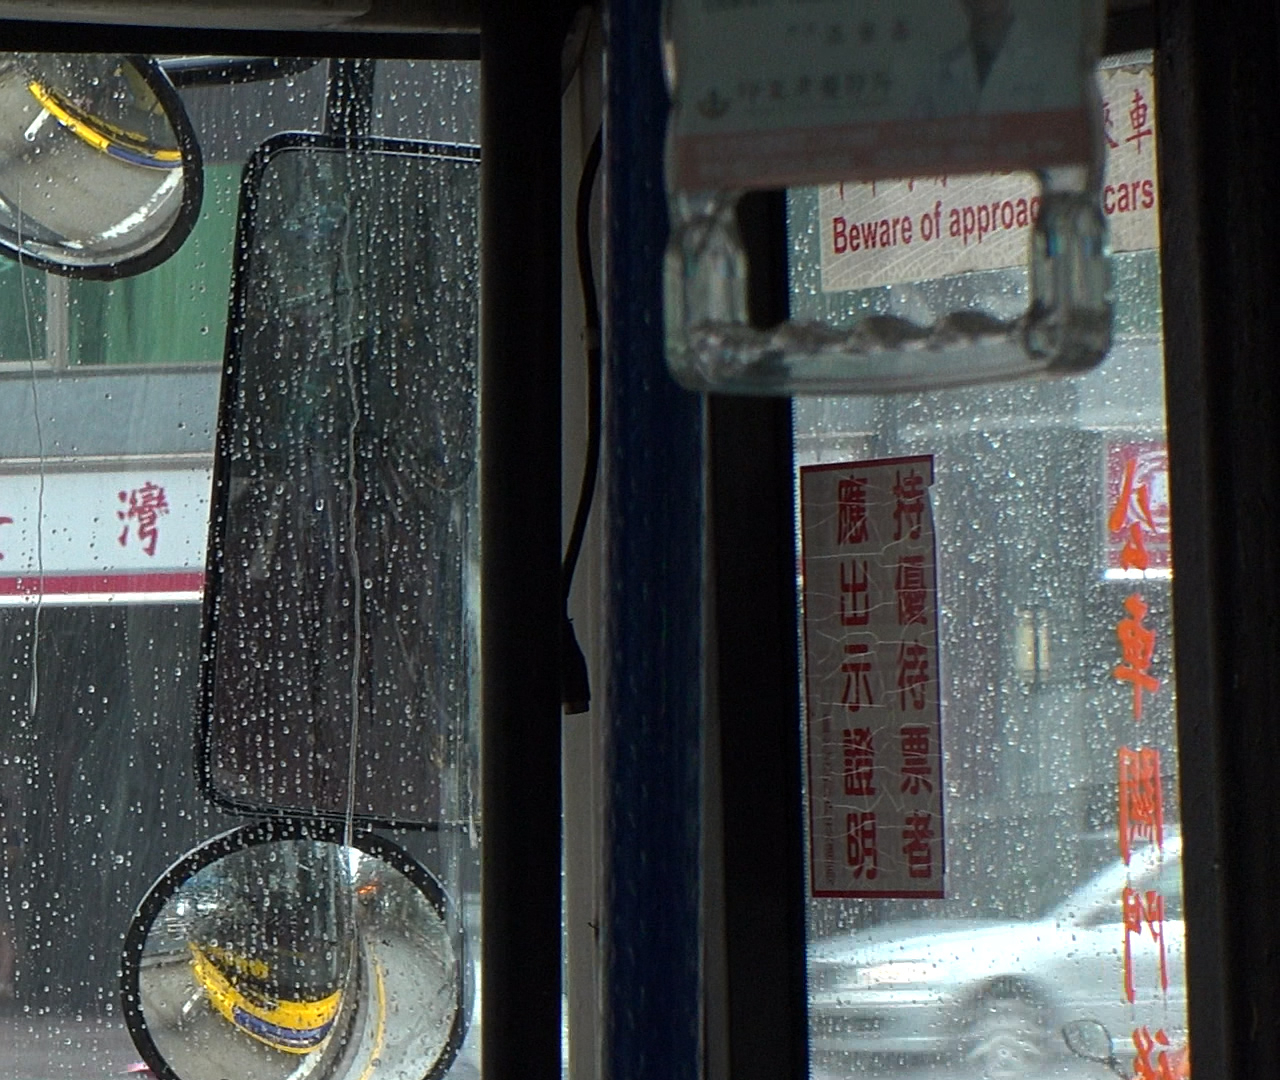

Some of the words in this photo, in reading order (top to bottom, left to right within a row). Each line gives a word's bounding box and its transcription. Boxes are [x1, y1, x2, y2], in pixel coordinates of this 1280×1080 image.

[833, 215, 912, 254] Beware
[921, 201, 943, 238] of
[950, 194, 1040, 244] approac
[1104, 178, 1155, 214] cars
[837, 474, 878, 881] 應出示證明
[892, 470, 933, 880] 持優待票者
